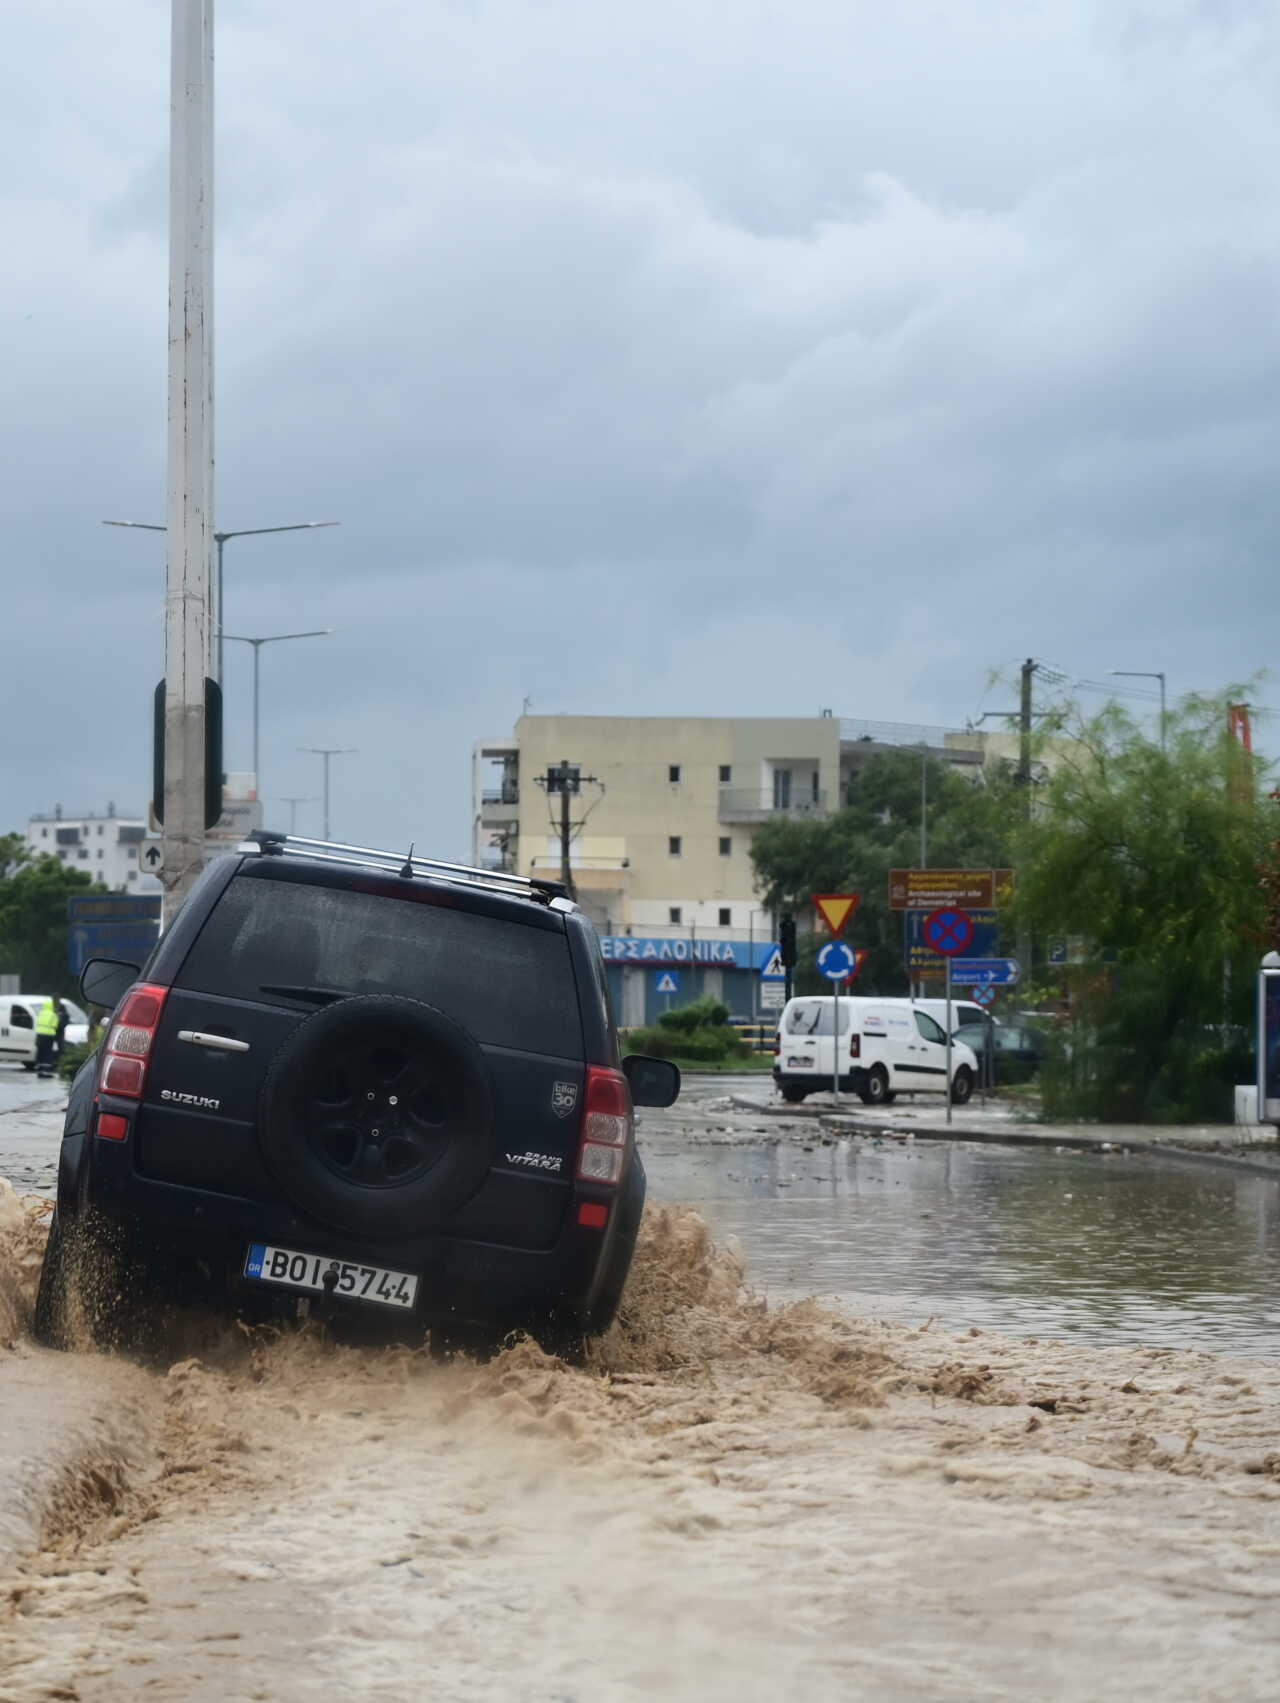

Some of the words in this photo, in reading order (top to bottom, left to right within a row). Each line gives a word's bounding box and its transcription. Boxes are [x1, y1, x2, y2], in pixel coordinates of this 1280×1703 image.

[160, 1089, 220, 1109] SUZUKI
[505, 1153, 561, 1172] VITARA
[339, 1262, 410, 1304] 5744
